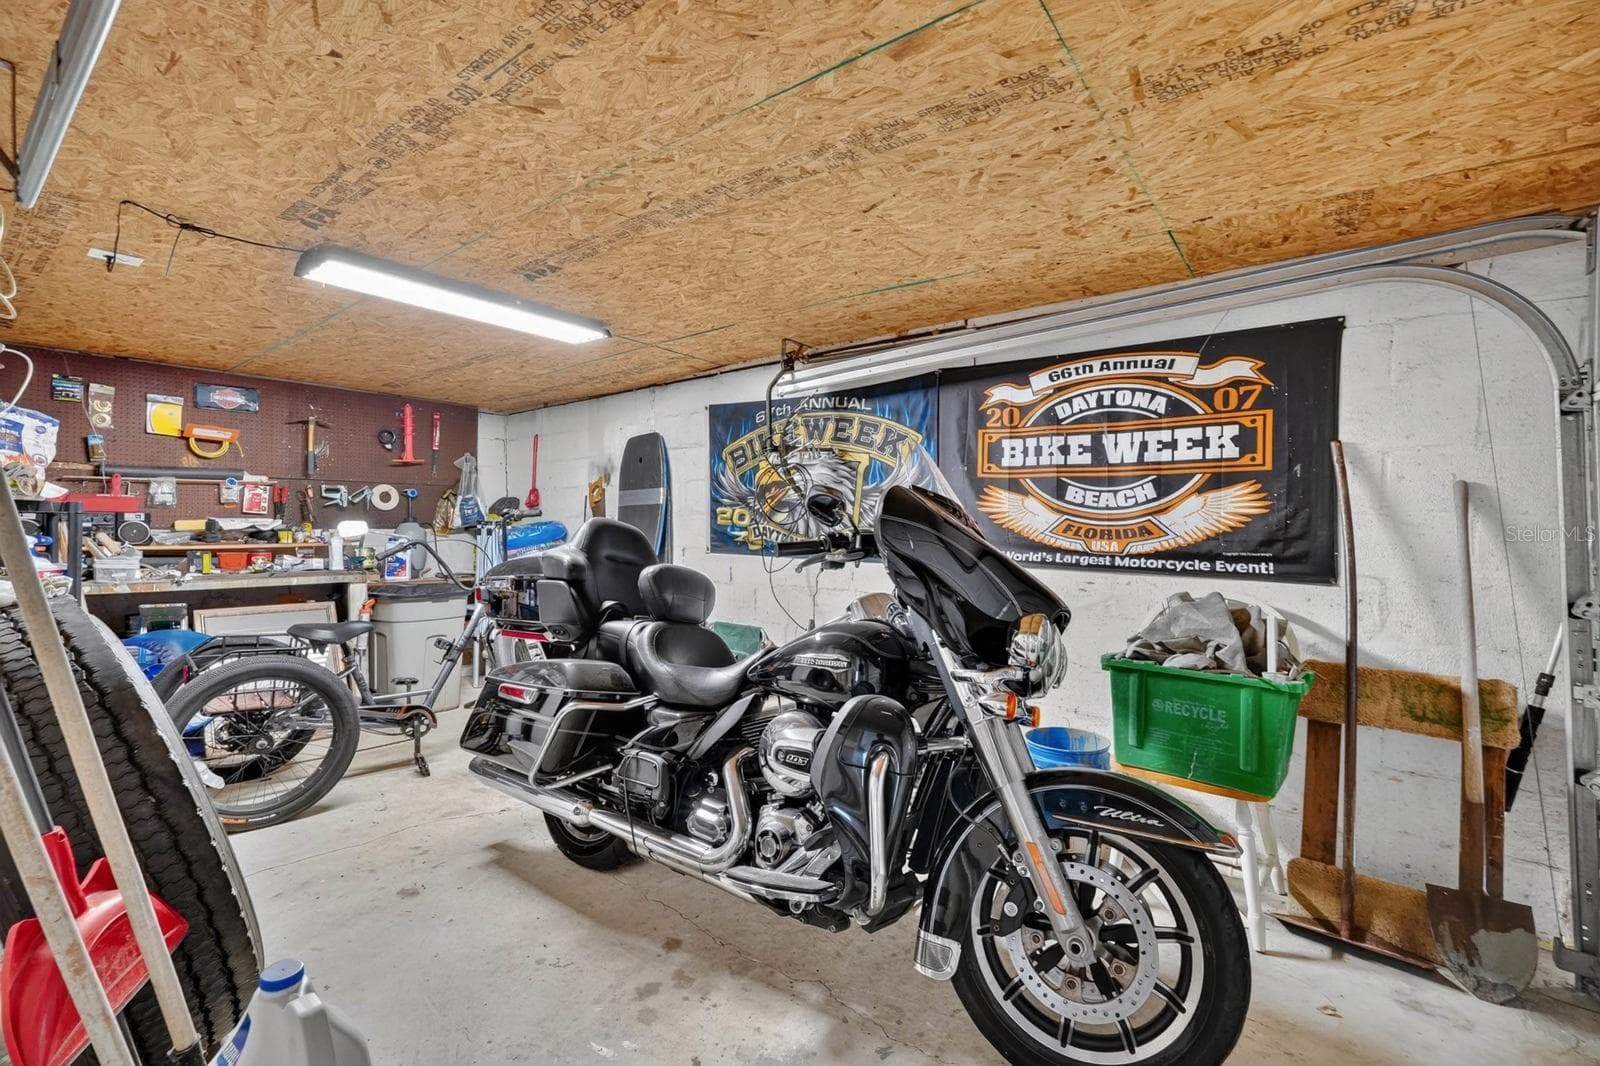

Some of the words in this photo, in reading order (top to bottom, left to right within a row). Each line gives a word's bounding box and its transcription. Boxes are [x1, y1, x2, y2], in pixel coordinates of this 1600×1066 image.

[522, 263, 562, 282] APA
[1047, 361, 1094, 383] 66th
[1099, 357, 1176, 373] Annual
[755, 403, 791, 424] 6th
[799, 397, 872, 411] ANNUAL
[985, 407, 1021, 428] 20
[1212, 385, 1263, 412] 07
[1054, 390, 1168, 420] DAYTONA
[801, 416, 909, 463] WEEK
[1000, 434, 1092, 468] BIKE
[1102, 424, 1240, 464] WEEK
[1064, 482, 1158, 508] BEACH
[716, 506, 751, 527] 20
[1061, 522, 1155, 541] FLORIDA
[1090, 540, 1119, 552] USA
[1002, 551, 1053, 563] World's
[1055, 553, 1111, 567] Largest
[1115, 555, 1211, 573] Motorcycle
[1215, 560, 1275, 575] Event!
[1165, 701, 1226, 724] RECYCLE
[1094, 805, 1165, 827] Ultra
